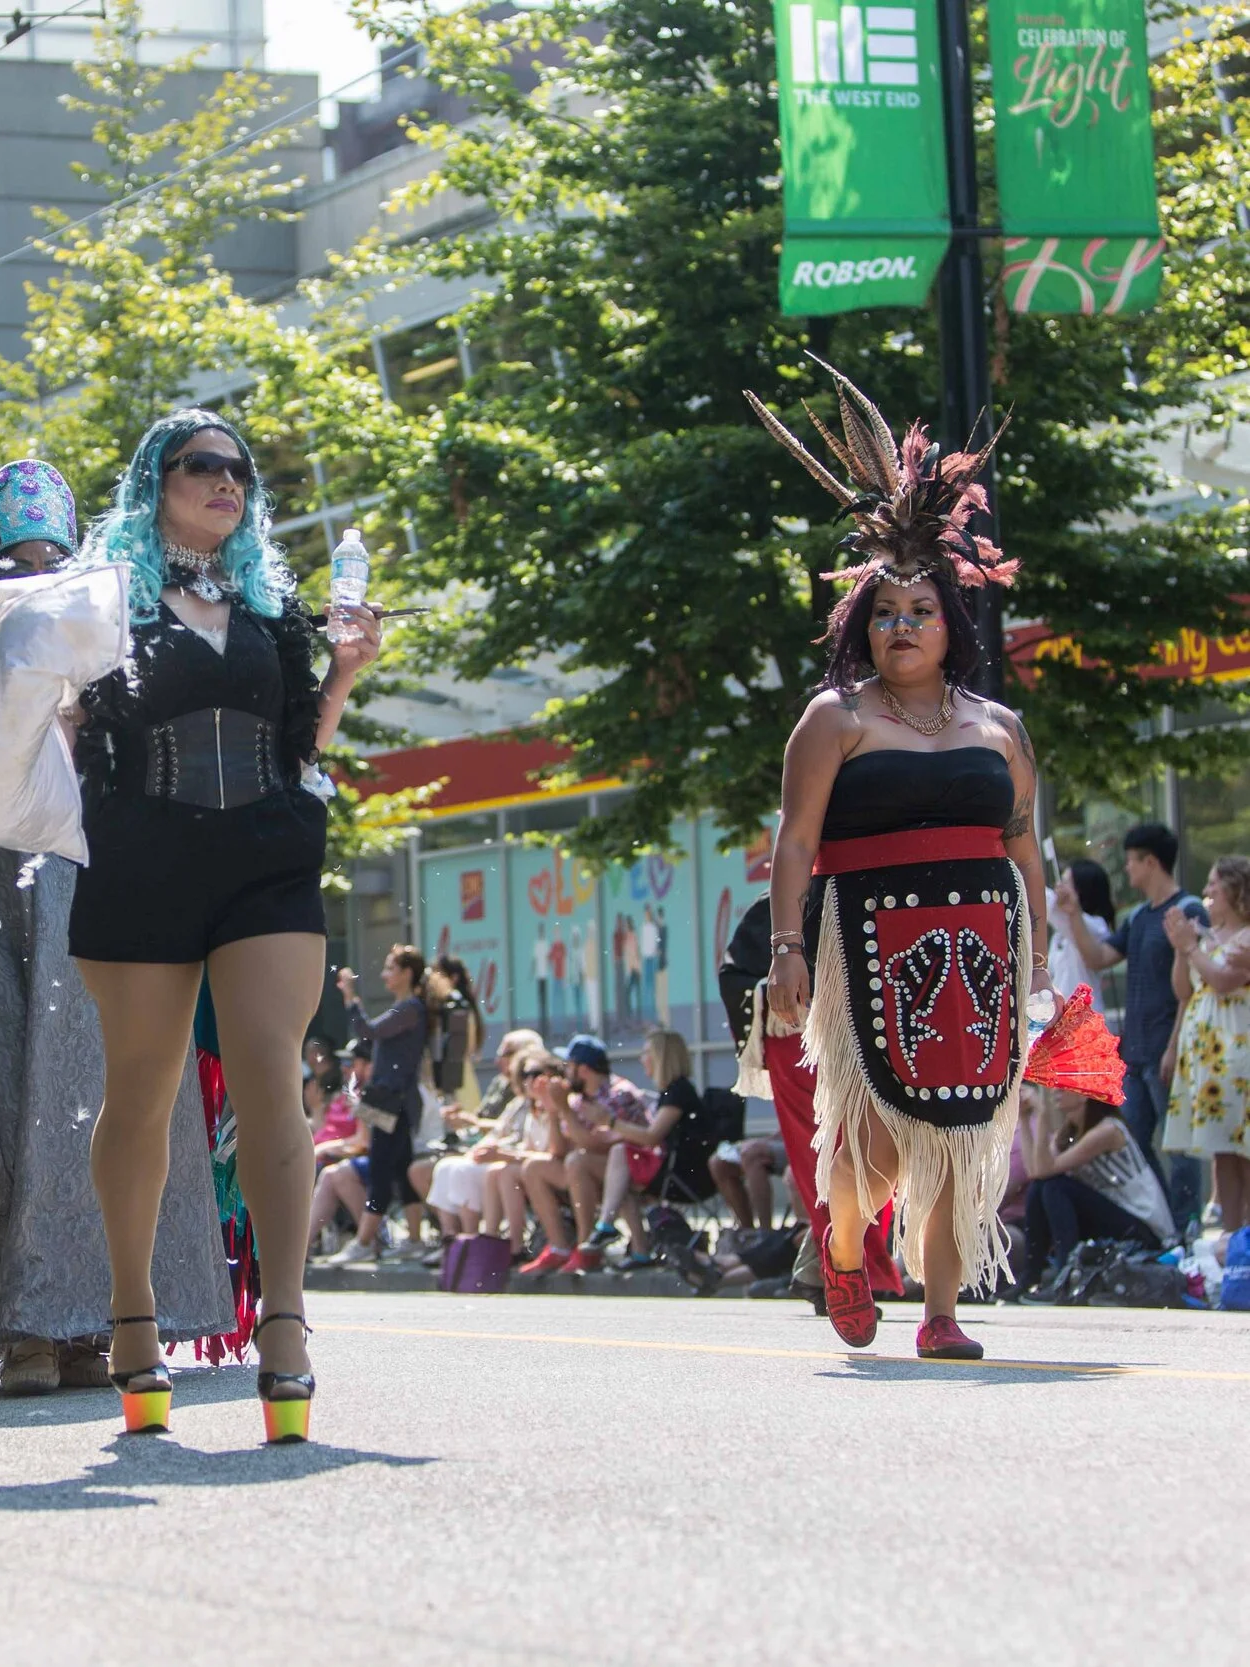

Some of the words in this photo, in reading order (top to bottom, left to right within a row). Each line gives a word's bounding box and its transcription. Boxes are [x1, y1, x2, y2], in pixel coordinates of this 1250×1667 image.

[1017, 28, 1107, 48] CELEBRATION
[1109, 29, 1127, 48] OF
[1008, 42, 1135, 129] Light
[793, 88, 831, 105] THE
[834, 89, 882, 107] WEST
[886, 91, 920, 108] END
